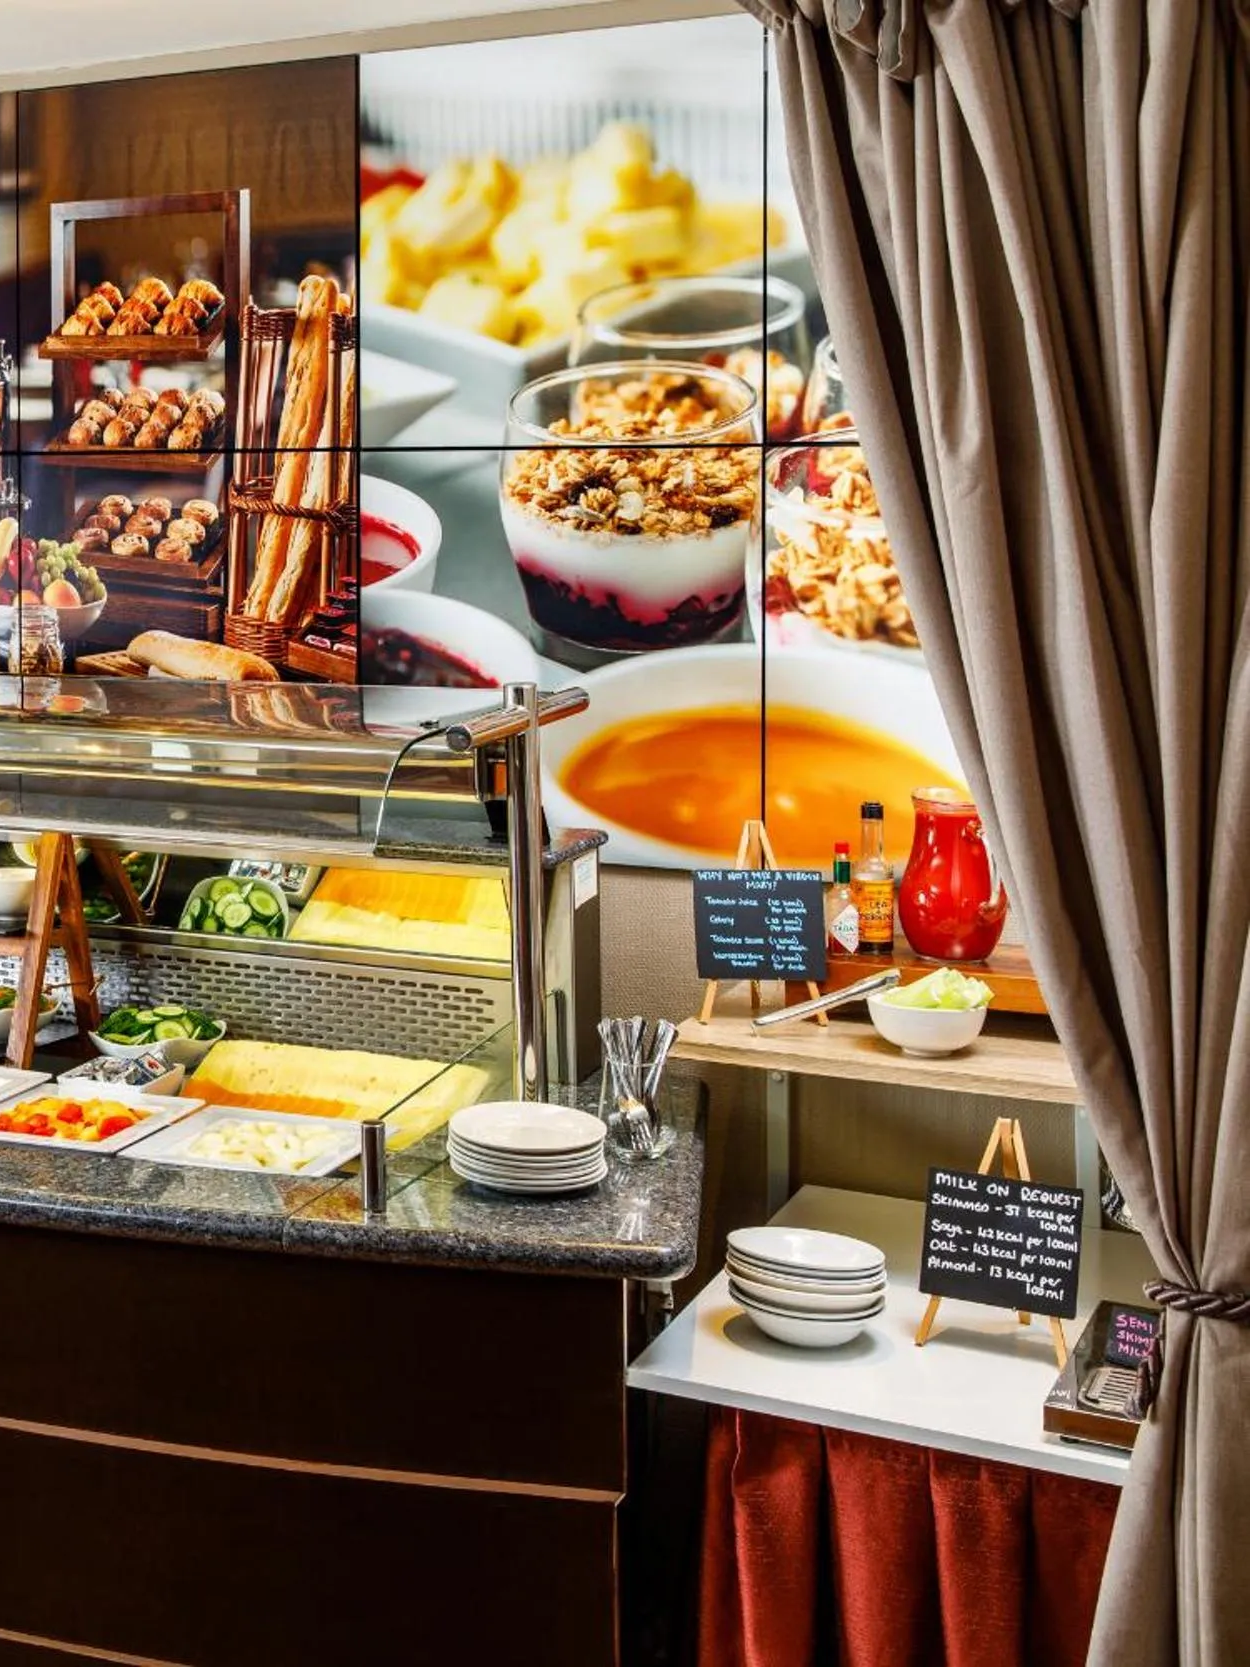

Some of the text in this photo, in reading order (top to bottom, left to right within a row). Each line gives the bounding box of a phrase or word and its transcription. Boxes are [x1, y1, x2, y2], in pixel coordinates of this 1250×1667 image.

[697, 871, 723, 881] WHY
[935, 1172, 1082, 1210] MILK ON REQUEST
[1004, 1204, 1020, 1217] 37
[1027, 1206, 1054, 1221] kcal
[1056, 1213, 1076, 1226] per
[931, 1218, 963, 1238] Soya
[1026, 1236, 1044, 1250] per
[1047, 1236, 1078, 1253] 100ml
[929, 1238, 958, 1253] Oat
[1020, 1253, 1037, 1268] per
[990, 1265, 1003, 1278] 13
[1006, 1268, 1035, 1283] kcal
[1040, 1276, 1062, 1288] per
[1115, 1313, 1153, 1334] SEMI
[1117, 1343, 1150, 1357] MILK
